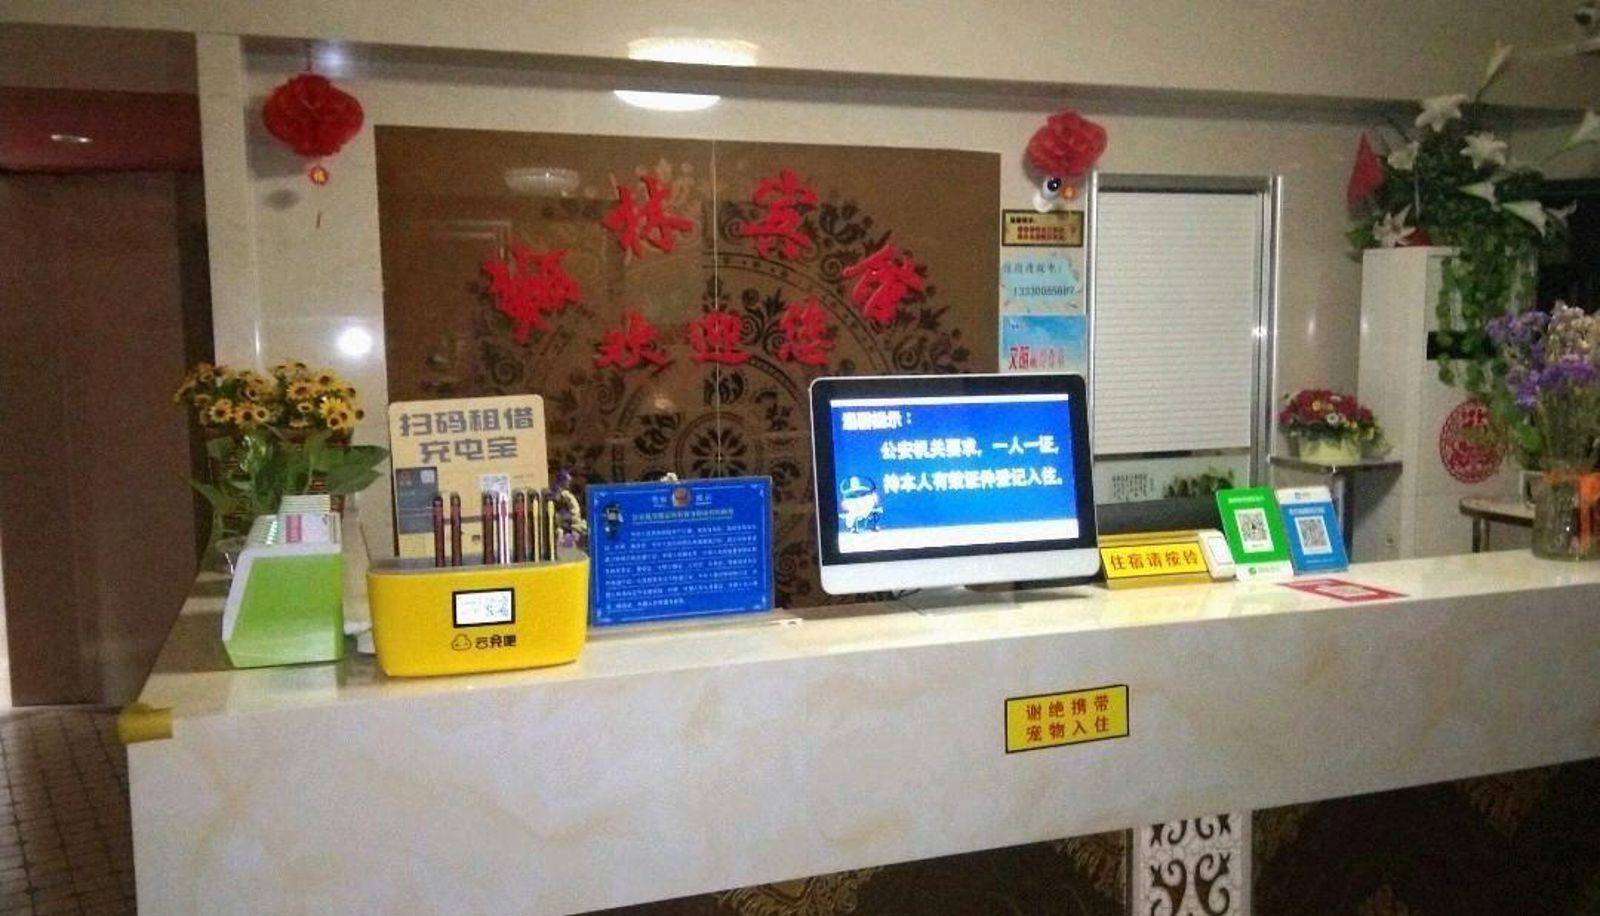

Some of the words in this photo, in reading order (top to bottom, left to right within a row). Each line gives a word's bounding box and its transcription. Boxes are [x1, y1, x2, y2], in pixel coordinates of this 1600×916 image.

[594, 295, 835, 367] 欢迎您
[399, 407, 534, 437] 扫码租借
[419, 436, 518, 464] 充电宝
[1110, 549, 1199, 571] 住宿请按铃
[1026, 694, 1109, 721] 谢绝携带
[1026, 715, 1109, 743] 宠物入住
